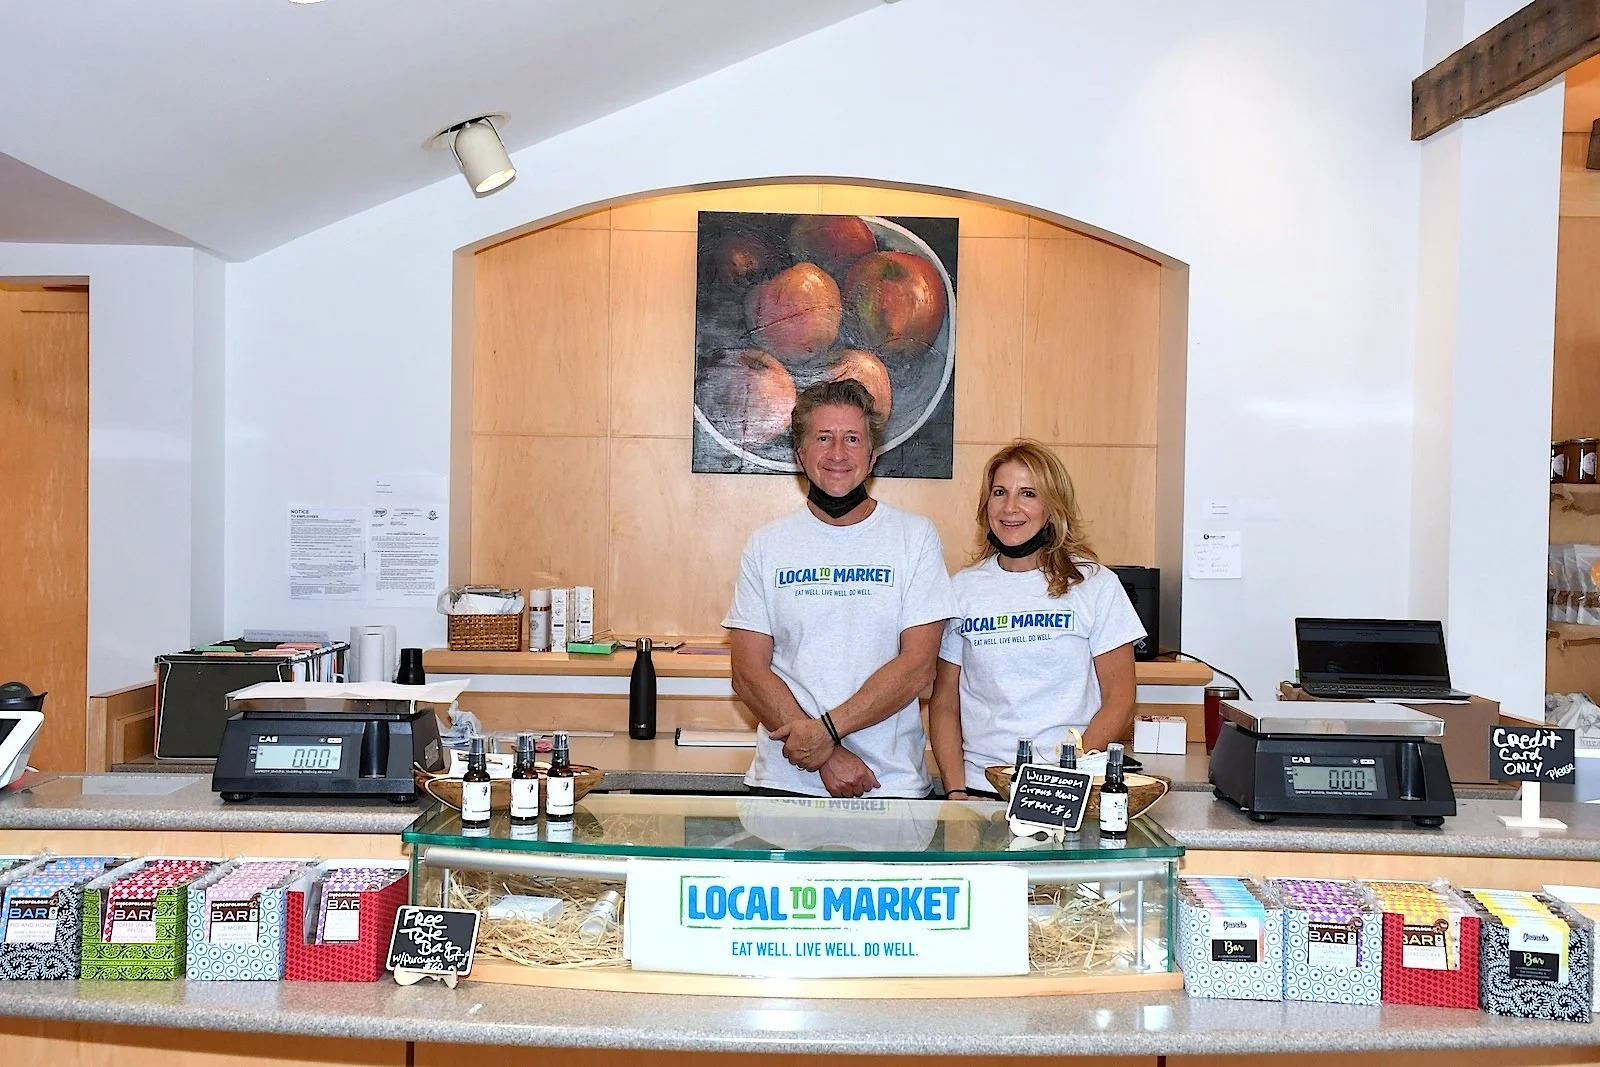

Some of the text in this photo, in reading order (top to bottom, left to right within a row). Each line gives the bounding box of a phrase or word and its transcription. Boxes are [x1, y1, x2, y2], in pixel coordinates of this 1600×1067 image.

[779, 567, 892, 585] LOCAL TO MARKET
[996, 615, 1008, 625] TO
[1011, 613, 1072, 629] MARKET
[974, 639, 983, 647] EAT
[1012, 635, 1027, 643] WELL.
[292, 748, 331, 768] 0.00
[1291, 756, 1311, 764] CAS
[1499, 748, 1543, 761] Card
[1503, 761, 1543, 778] ONLY
[1329, 769, 1366, 789] 0.00
[1019, 784, 1080, 802] CITRUS HAND
[1020, 797, 1053, 813] SPRAY
[327, 899, 360, 909] BAR
[688, 885, 960, 921] LOCAL TO MARKET
[9, 907, 48, 919] BAR
[114, 909, 151, 921] BAR
[211, 910, 248, 921] BAR
[403, 909, 448, 929] Free
[398, 927, 449, 942] Tote
[1308, 931, 1346, 943] BAR
[415, 941, 462, 959] Bag
[732, 942, 919, 957] EAT WELL. LIVE WELL. DO WELL.
[1223, 940, 1245, 955] Bar
[1522, 952, 1545, 967] Bar
